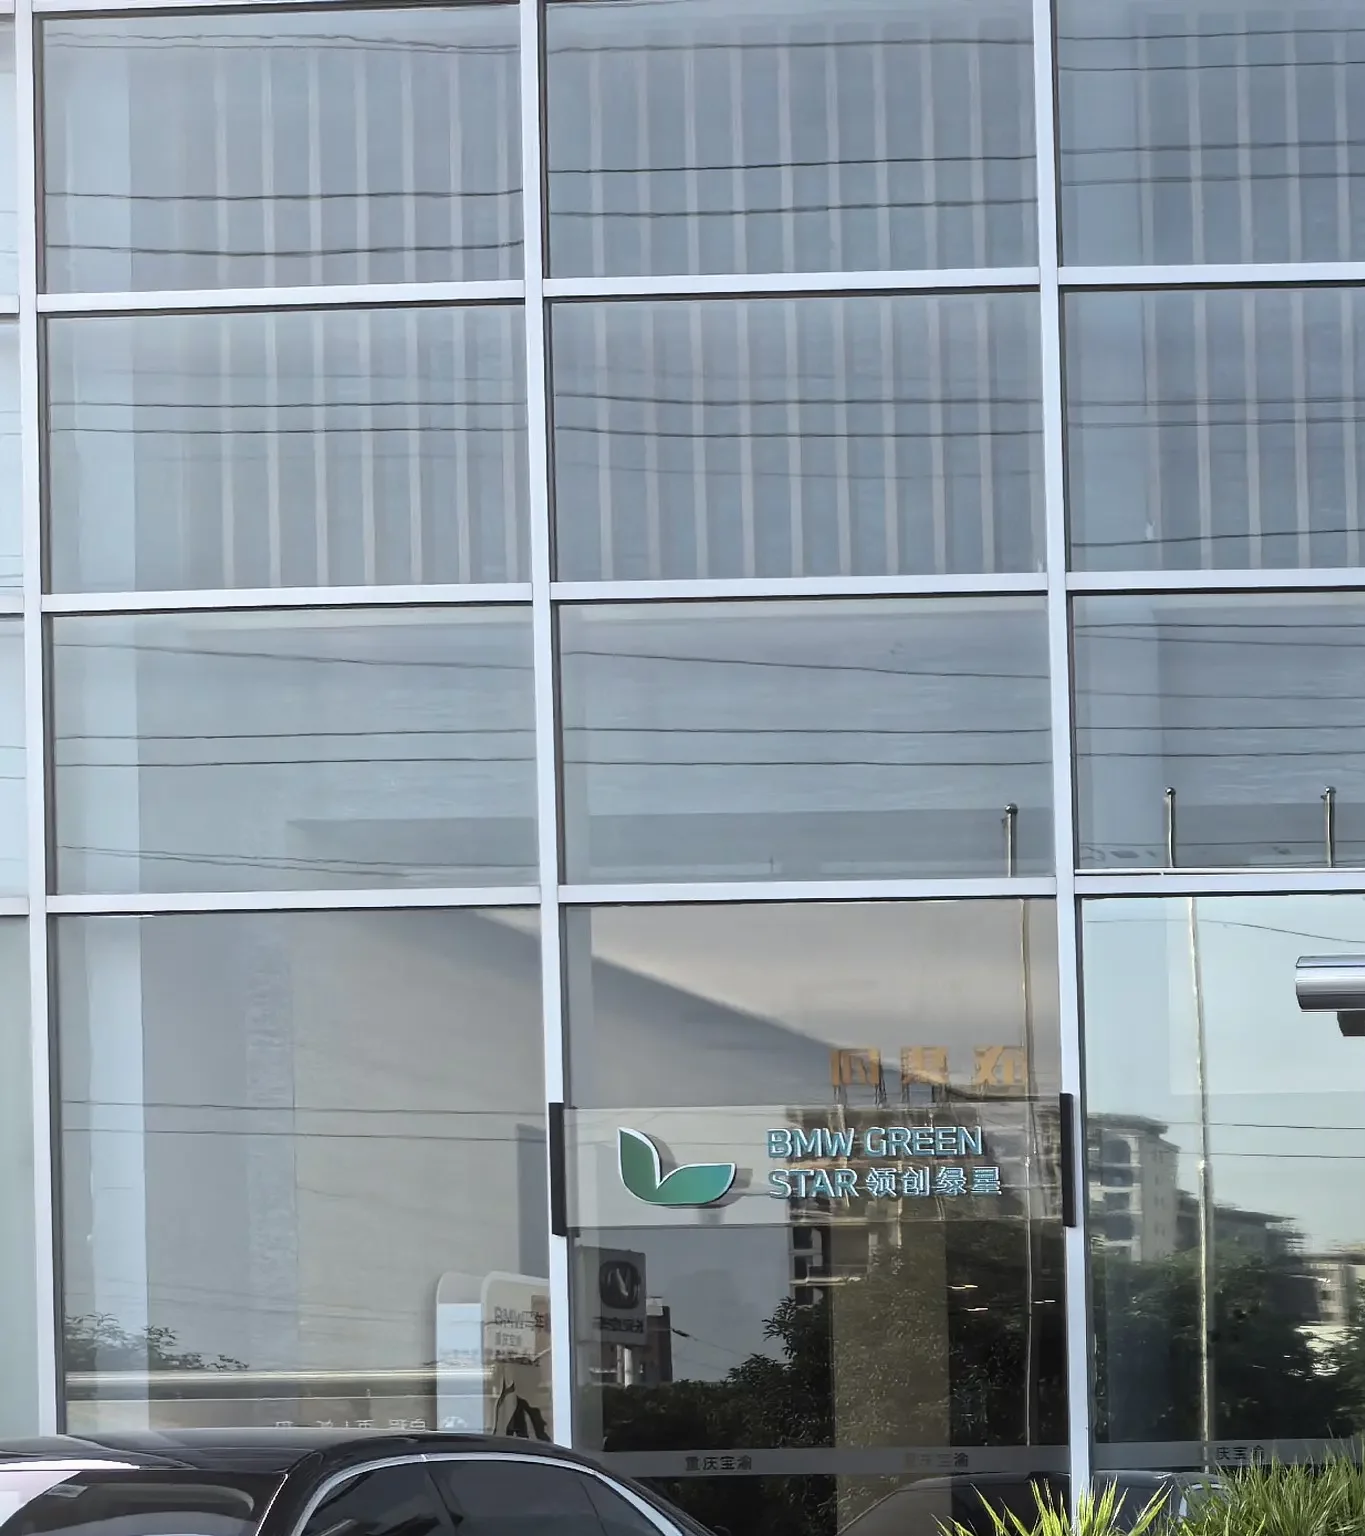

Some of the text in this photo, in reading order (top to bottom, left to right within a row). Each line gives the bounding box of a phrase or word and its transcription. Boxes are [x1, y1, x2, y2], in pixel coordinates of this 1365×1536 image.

[767, 1126, 984, 1158] BMW GREEN
[769, 1166, 1002, 1199] STAR 领创绿星
